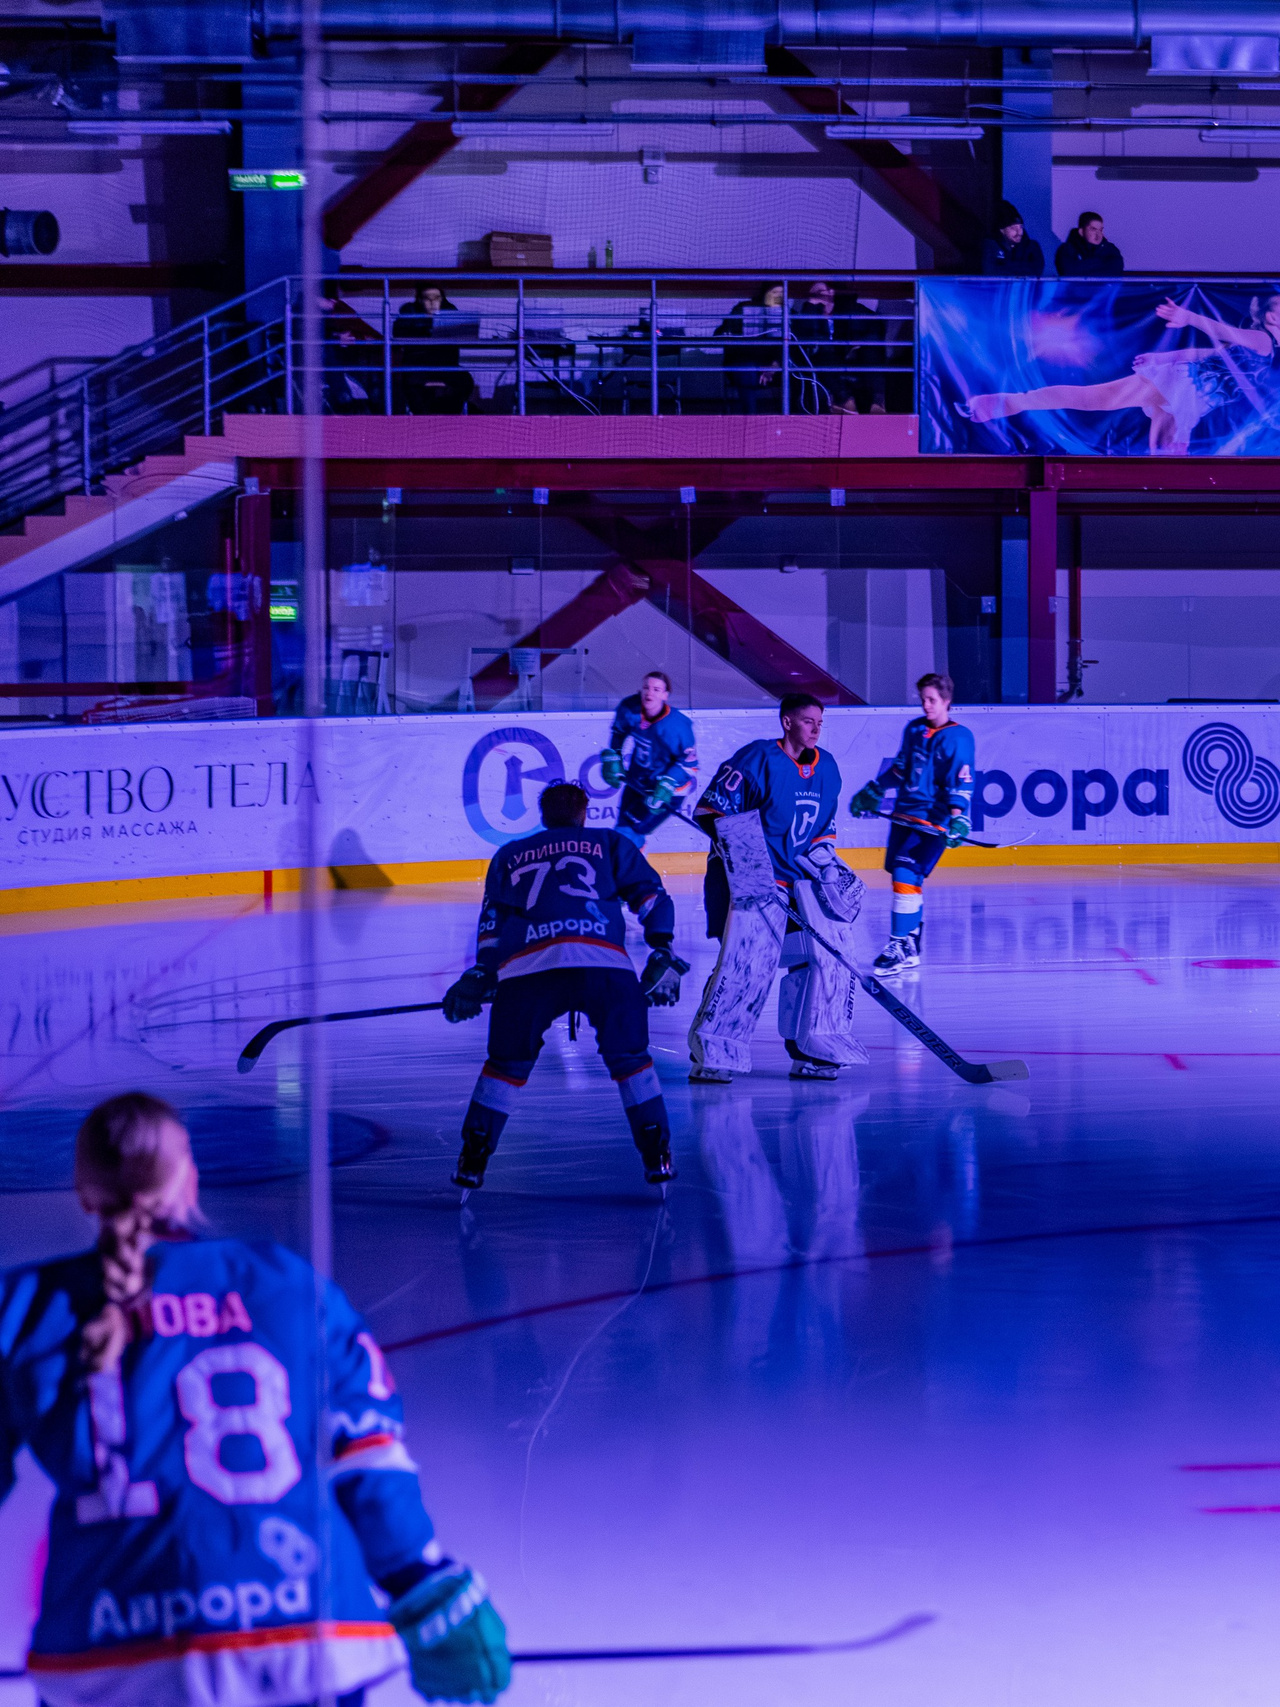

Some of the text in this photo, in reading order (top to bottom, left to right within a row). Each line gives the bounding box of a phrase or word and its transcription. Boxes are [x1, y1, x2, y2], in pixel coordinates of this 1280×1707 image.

[194, 760, 321, 809] ТЕЛА
[716, 764, 743, 792] 70
[862, 757, 1169, 832] рора
[957, 764, 974, 783] 4
[17, 820, 198, 846] СТУДИЯ МАССАЖА
[510, 855, 600, 911] 73
[525, 918, 607, 944] Аврора
[893, 1006, 963, 1070] BAUER
[135, 1291, 252, 1338] ОВА
[75, 1342, 301, 1527] 18
